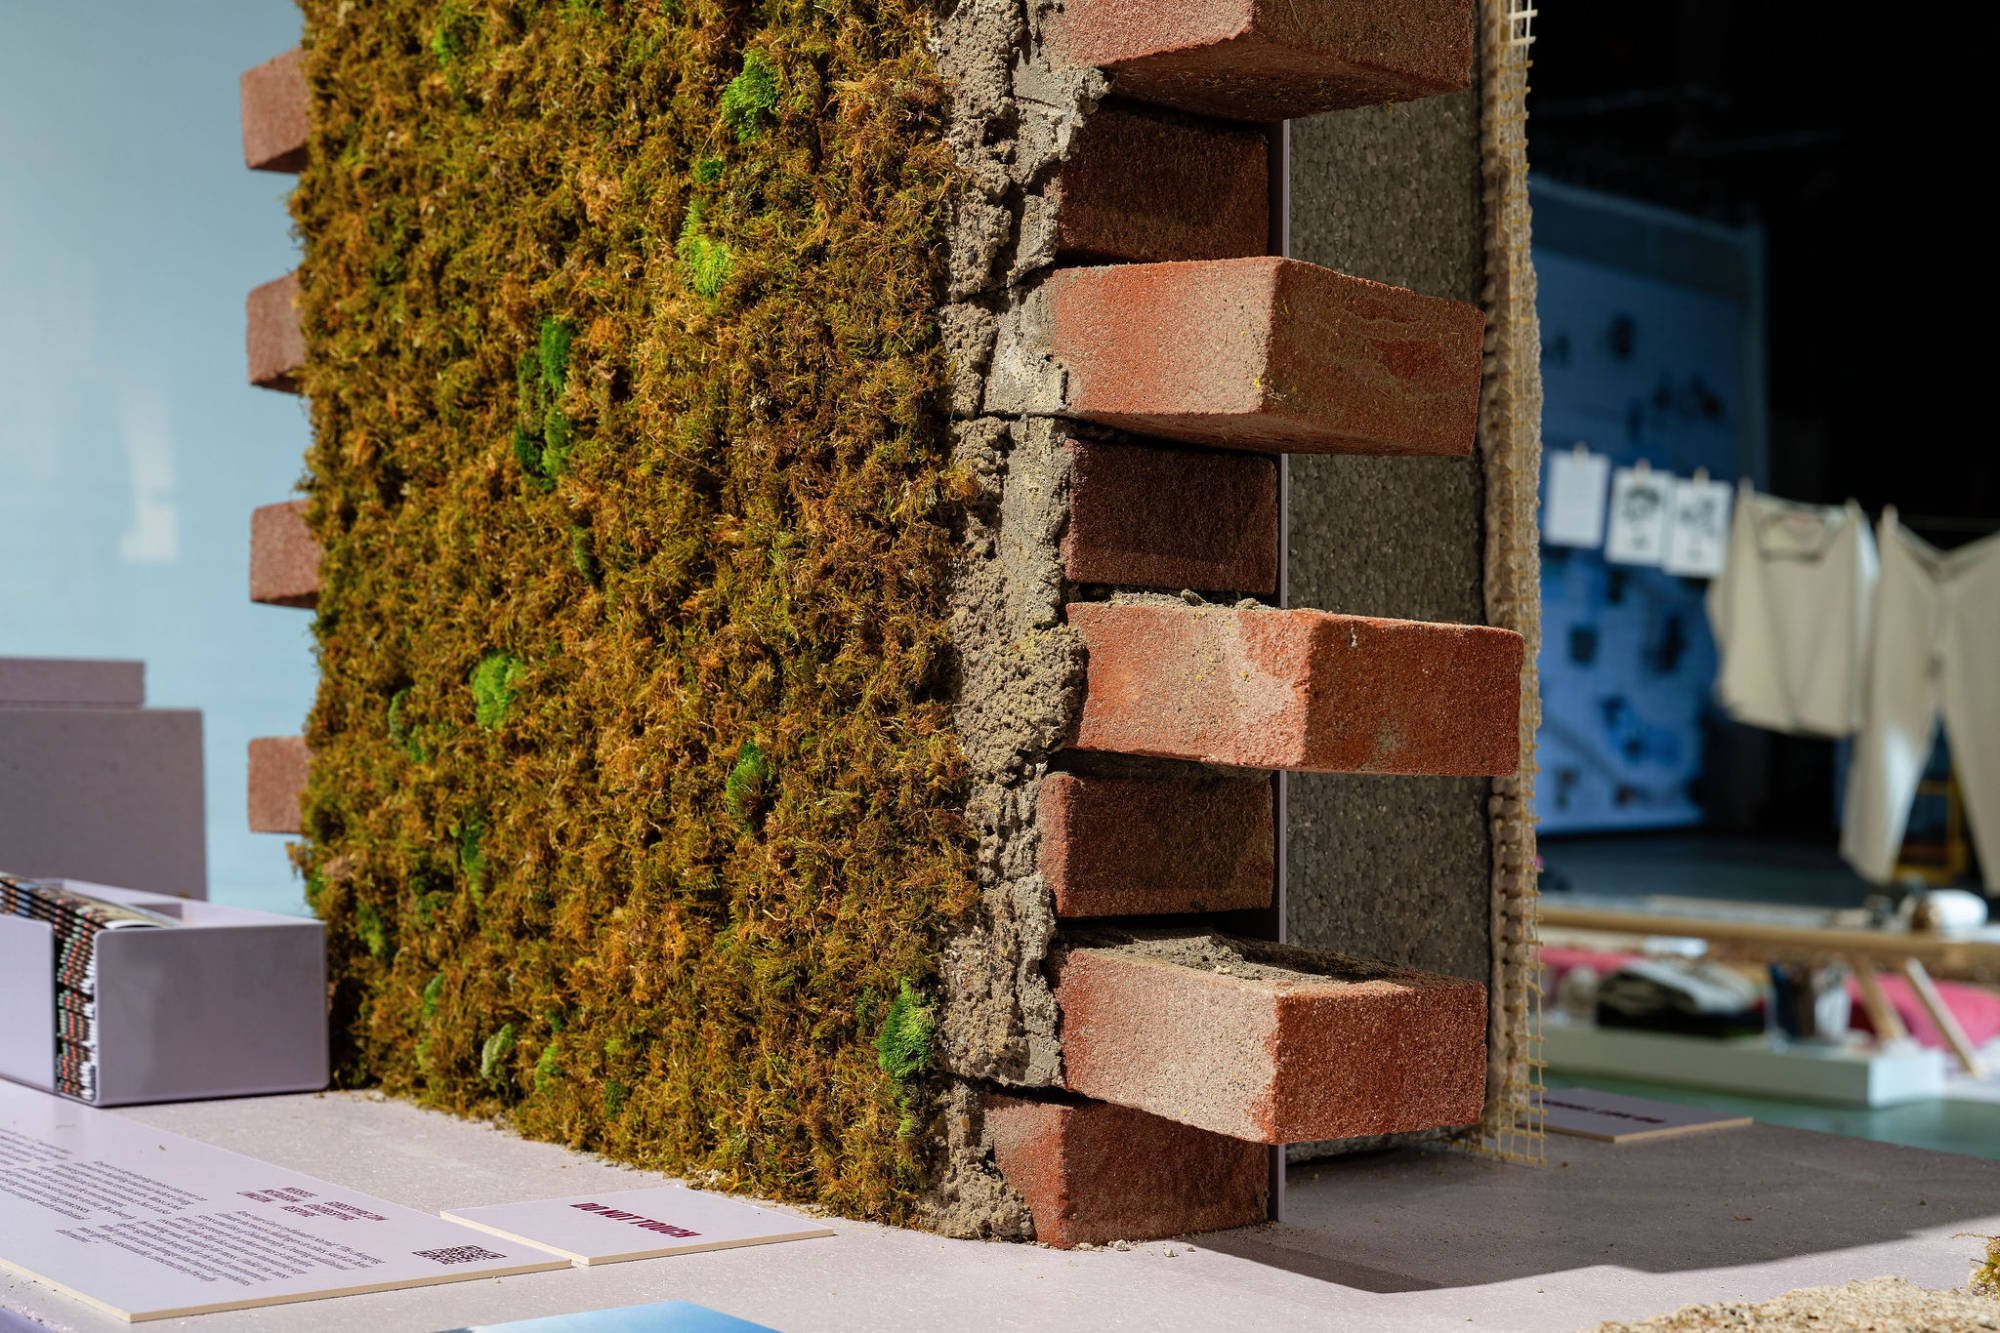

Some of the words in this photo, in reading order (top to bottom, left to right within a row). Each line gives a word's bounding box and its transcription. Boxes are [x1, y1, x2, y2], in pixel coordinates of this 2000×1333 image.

[569, 1202, 611, 1211] DO
[593, 1209, 645, 1221] NOT
[629, 1219, 702, 1238] TOUCH
